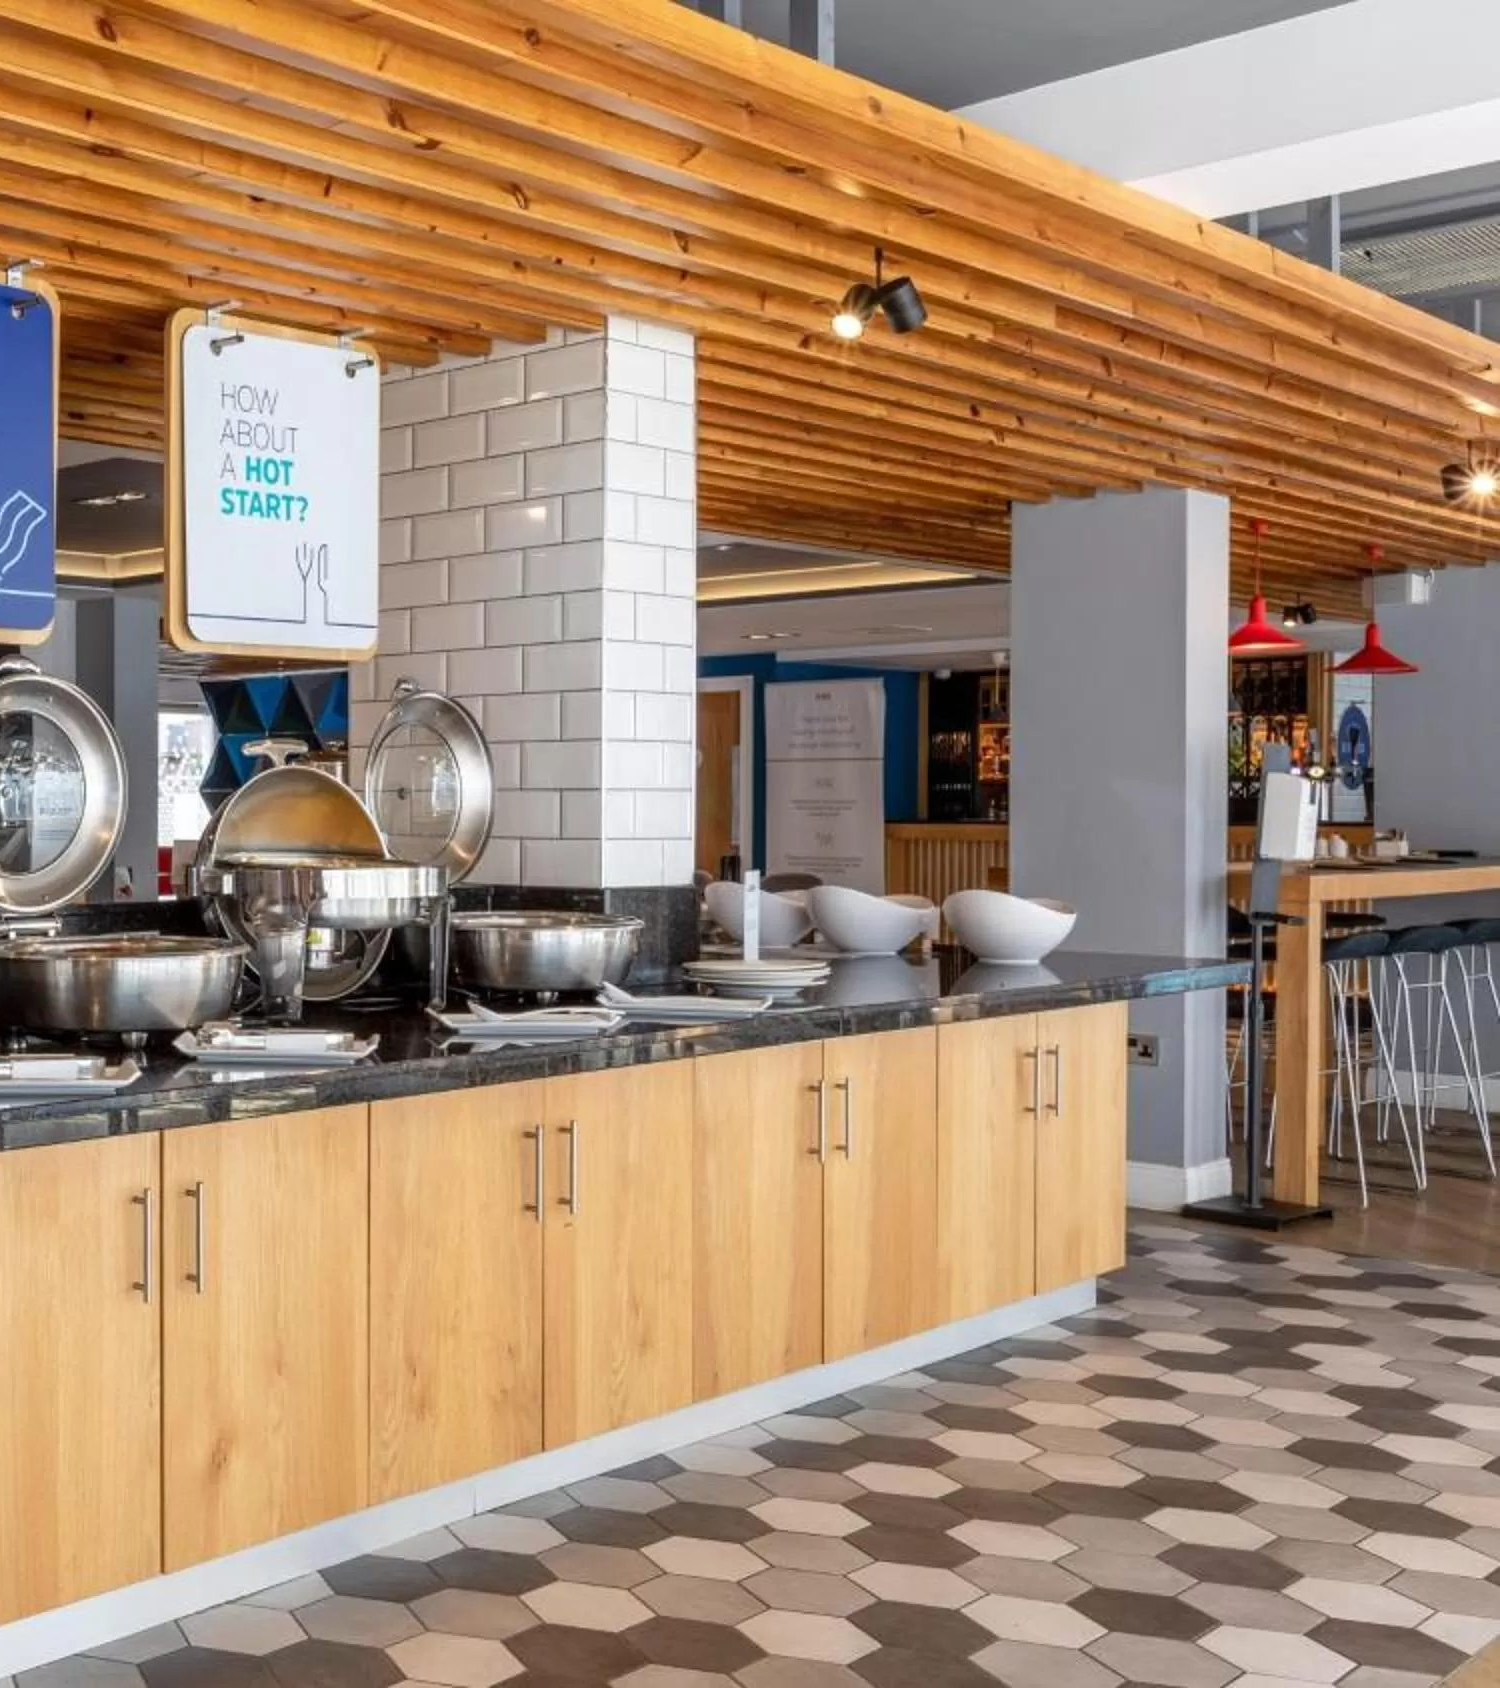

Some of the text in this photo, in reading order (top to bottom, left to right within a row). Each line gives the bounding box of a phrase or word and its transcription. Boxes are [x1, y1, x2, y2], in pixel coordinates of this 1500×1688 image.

[220, 382, 279, 416] HOW
[220, 420, 298, 453] ABOUT
[220, 451, 293, 486] A HOT
[220, 487, 309, 522] START?
